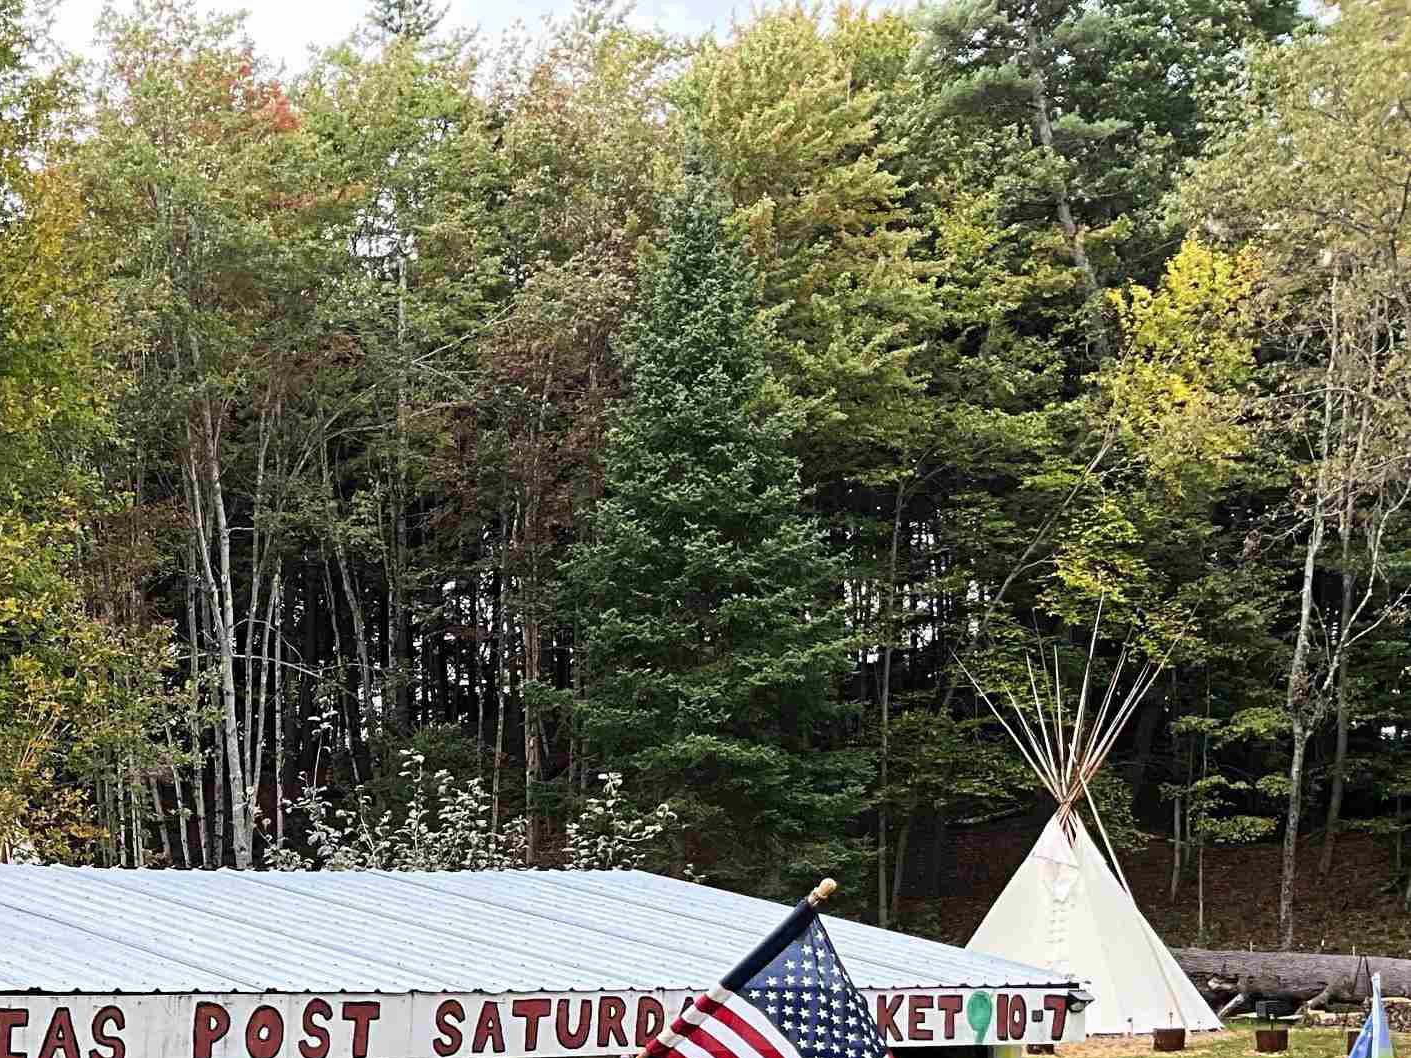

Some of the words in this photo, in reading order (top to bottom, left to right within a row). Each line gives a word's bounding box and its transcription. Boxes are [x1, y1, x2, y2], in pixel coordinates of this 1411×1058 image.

[433, 995, 694, 1056] SATURD
[876, 994, 963, 1042] KET
[996, 993, 1068, 1041] 10-7
